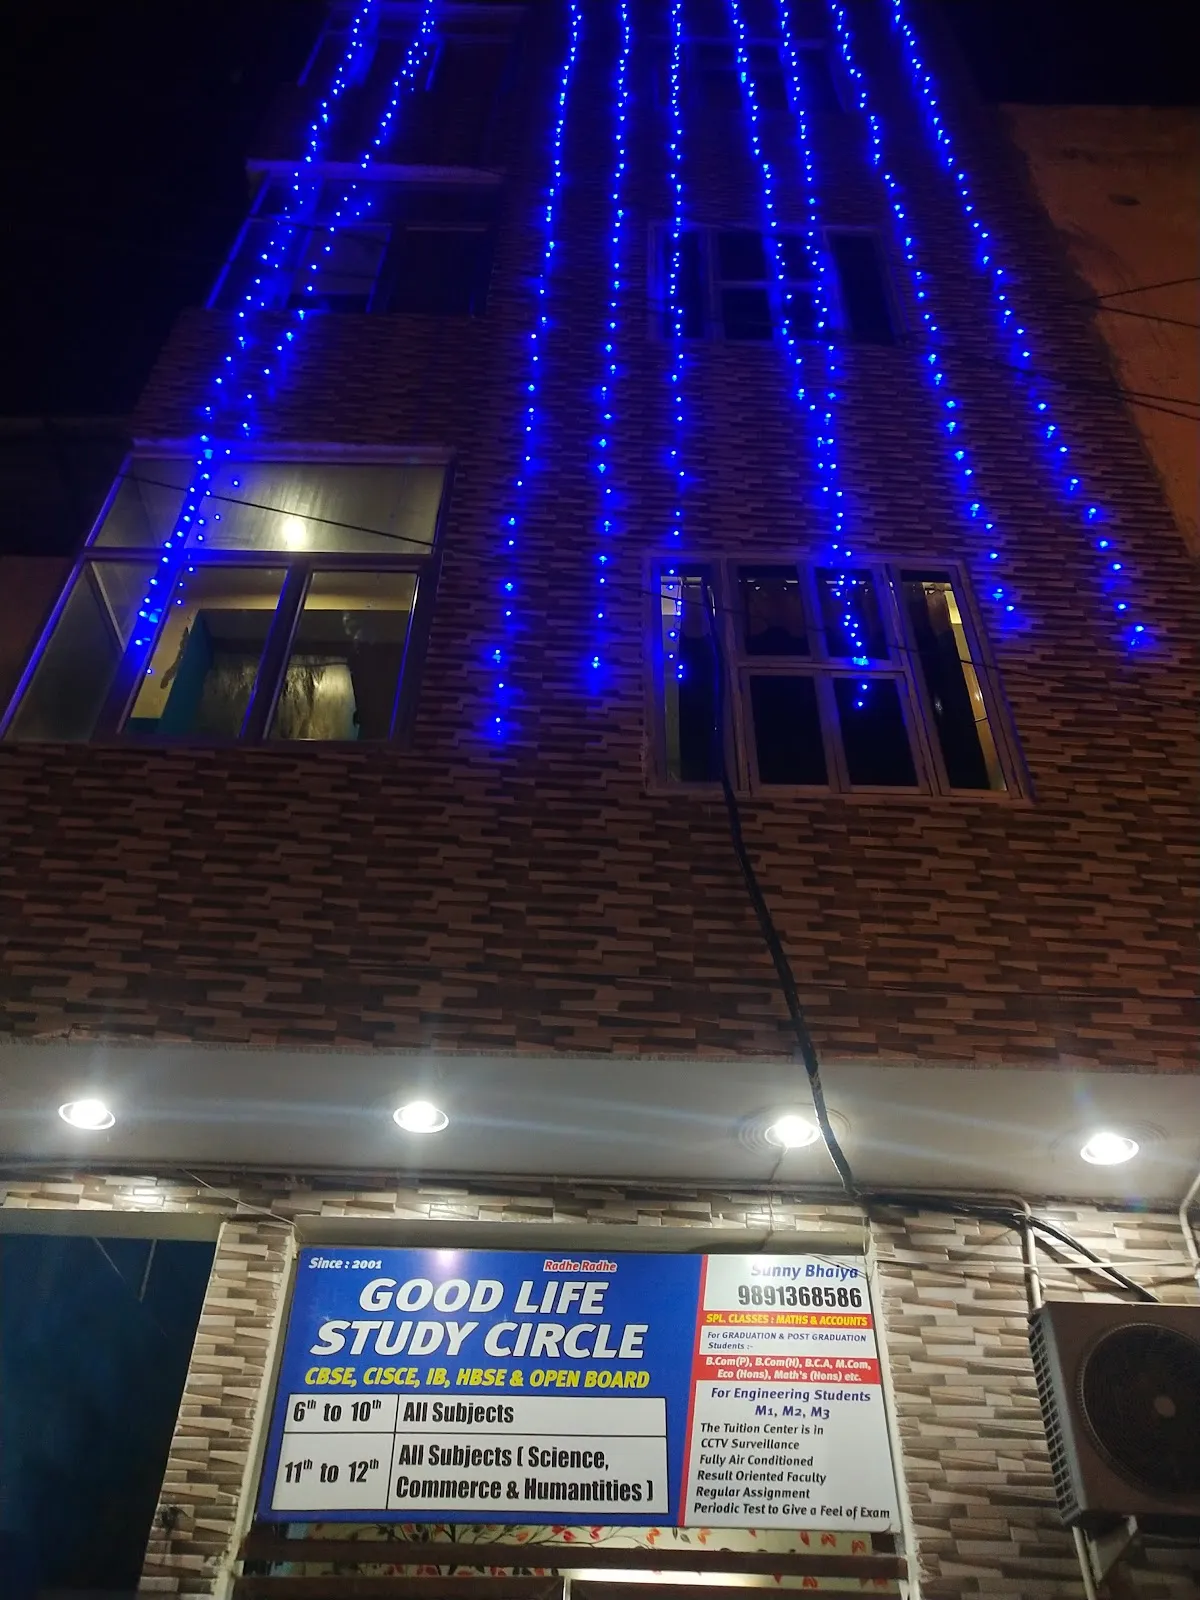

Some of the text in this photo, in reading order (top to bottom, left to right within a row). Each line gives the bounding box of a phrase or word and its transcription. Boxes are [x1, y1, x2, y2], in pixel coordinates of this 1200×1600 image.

[309, 1257, 342, 1269] Since
[352, 1260, 382, 1269] 2001
[544, 1260, 617, 1272] Radhe Radhe
[751, 1264, 858, 1281] Sunny Bhaiya
[359, 1278, 609, 1314] GOOD LIFE
[738, 1285, 862, 1308] 9891368586
[706, 1314, 725, 1323] SPL.
[729, 1314, 769, 1324] CLASSES
[776, 1315, 808, 1324] MATHS
[810, 1316, 817, 1325] &
[819, 1316, 868, 1326] ACCOUNTS
[309, 1320, 649, 1359] STUDY CIRCLE
[722, 1332, 776, 1340] GRADUATION
[708, 1342, 744, 1350] Students
[706, 1357, 871, 1370] B.Com(P), B.Com(H), B.C.A, M.Com,
[304, 1367, 650, 1388] CBSE, CISCE, IB, HBSE & OPEN BOARD
[718, 1369, 861, 1382] Eco (Hons), Math's (Hons) etc.
[711, 1388, 871, 1402] For Engineering Students
[293, 1400, 381, 1422] 6th to 10th
[403, 1402, 514, 1424] All Subjects
[755, 1405, 830, 1420] M1, M2, M3
[701, 1423, 824, 1435] The Tuition Center is in
[701, 1439, 799, 1450] CCTV Surveillance
[399, 1445, 424, 1466] All
[428, 1445, 512, 1469] Subjects
[528, 1446, 608, 1471] Science,
[700, 1455, 813, 1467] Fully Air Conditioned
[320, 1464, 339, 1483] to
[349, 1459, 379, 1484] 12th
[698, 1470, 826, 1485] Result Oriented Faculty
[396, 1476, 502, 1499] Commerce
[507, 1480, 520, 1500] &
[524, 1478, 643, 1501] Humantities
[696, 1486, 810, 1500] Regular Assignment
[694, 1503, 890, 1520] Periodic Test to Give a Feel of Exam
